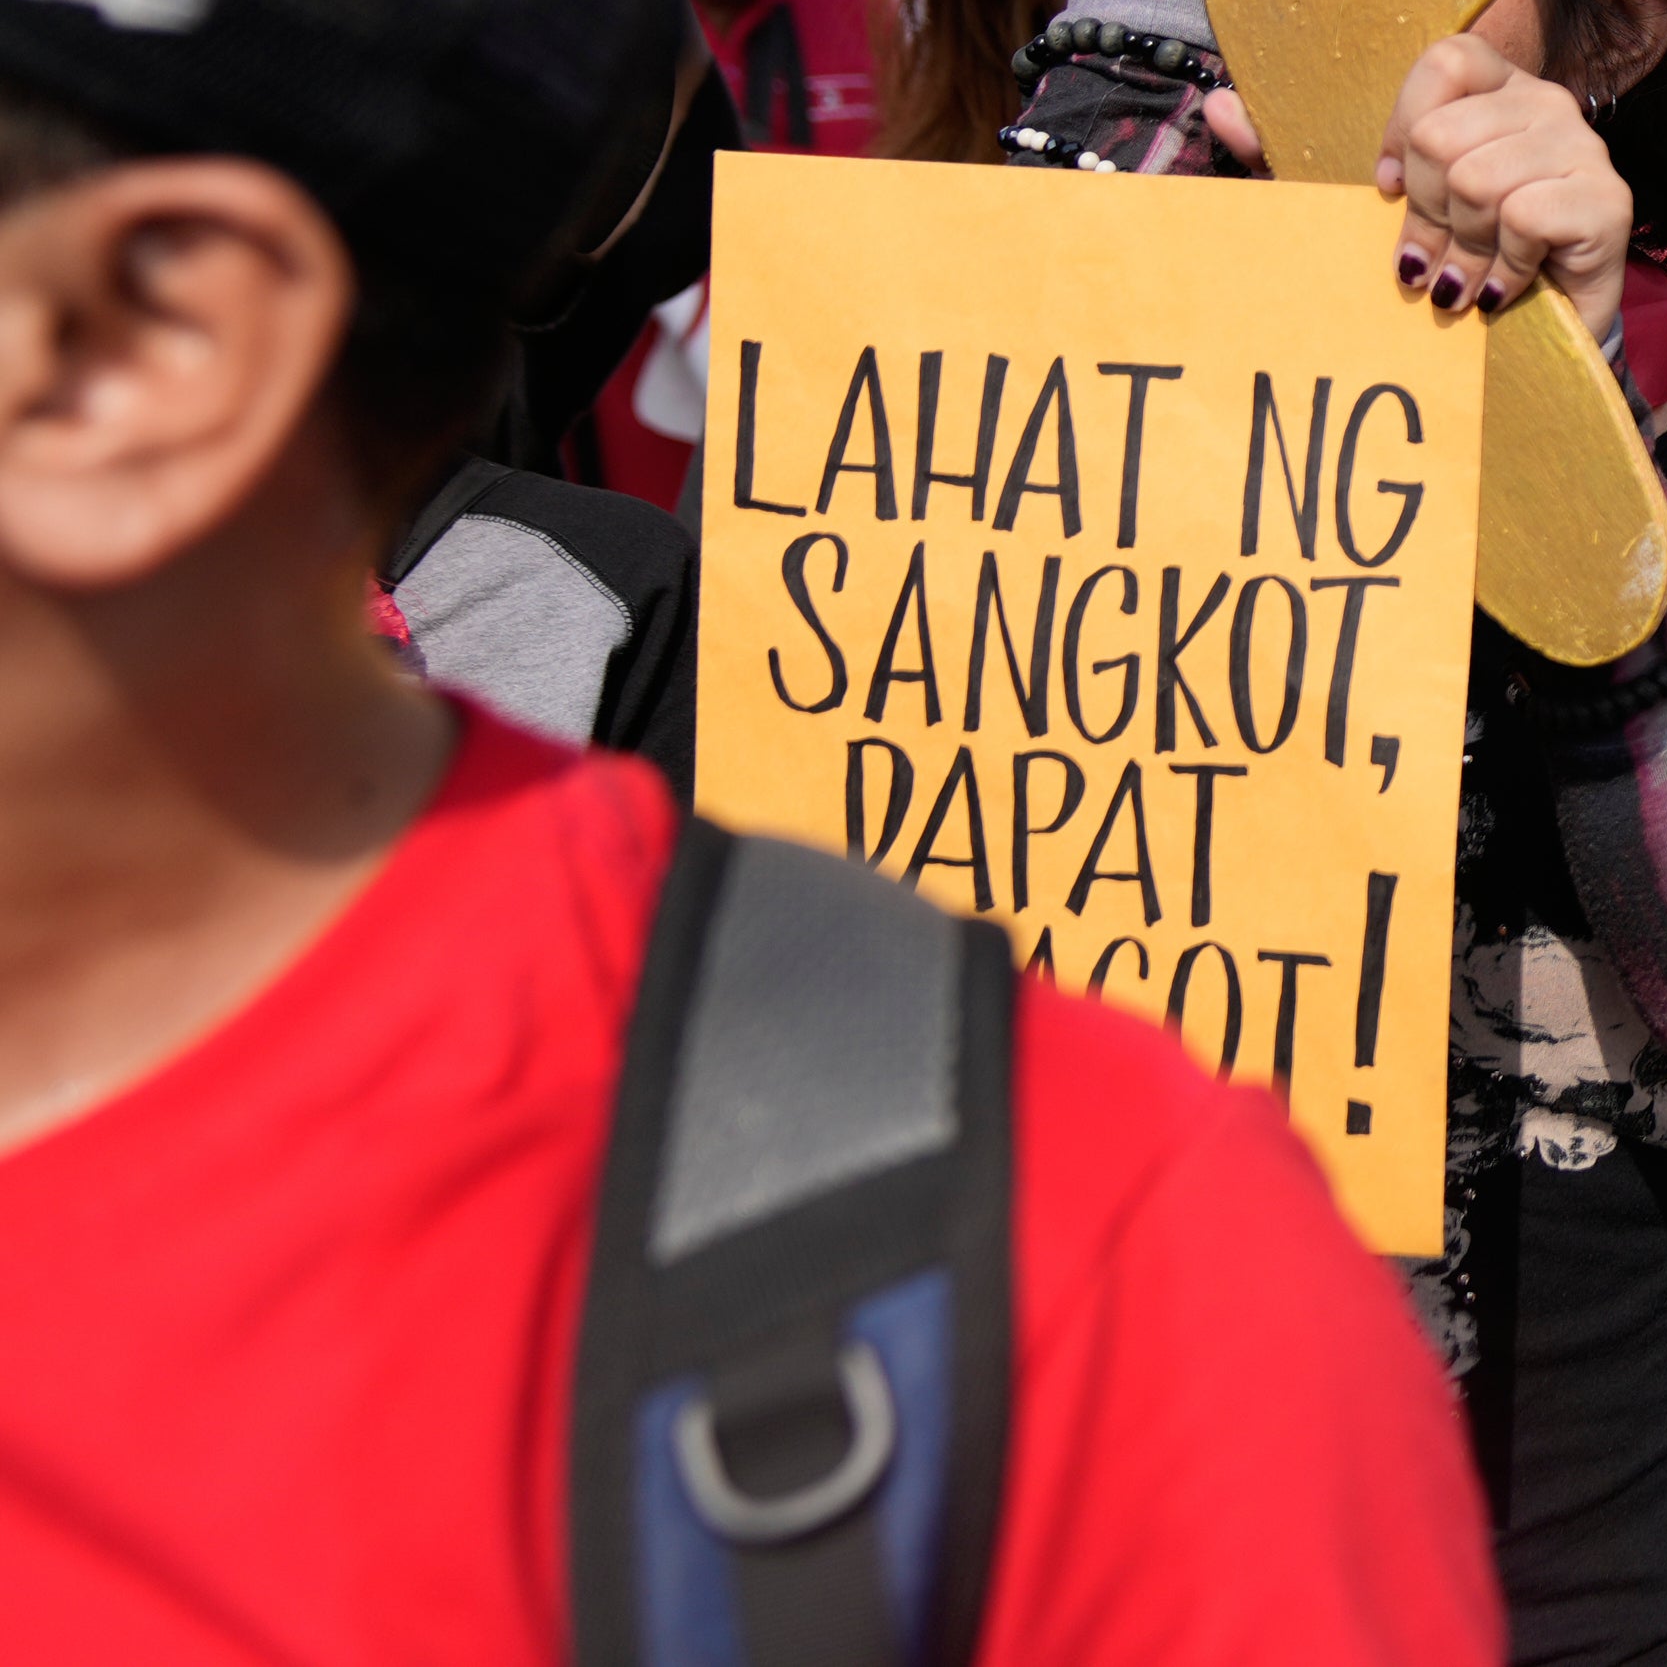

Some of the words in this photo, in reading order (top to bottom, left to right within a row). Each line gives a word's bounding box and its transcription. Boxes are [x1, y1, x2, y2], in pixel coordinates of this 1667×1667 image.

[734, 340, 1184, 548] LAHAT
[1241, 371, 1425, 567] NG
[768, 532, 1402, 794] SANGKOT,
[846, 738, 1249, 928] DAPAT
